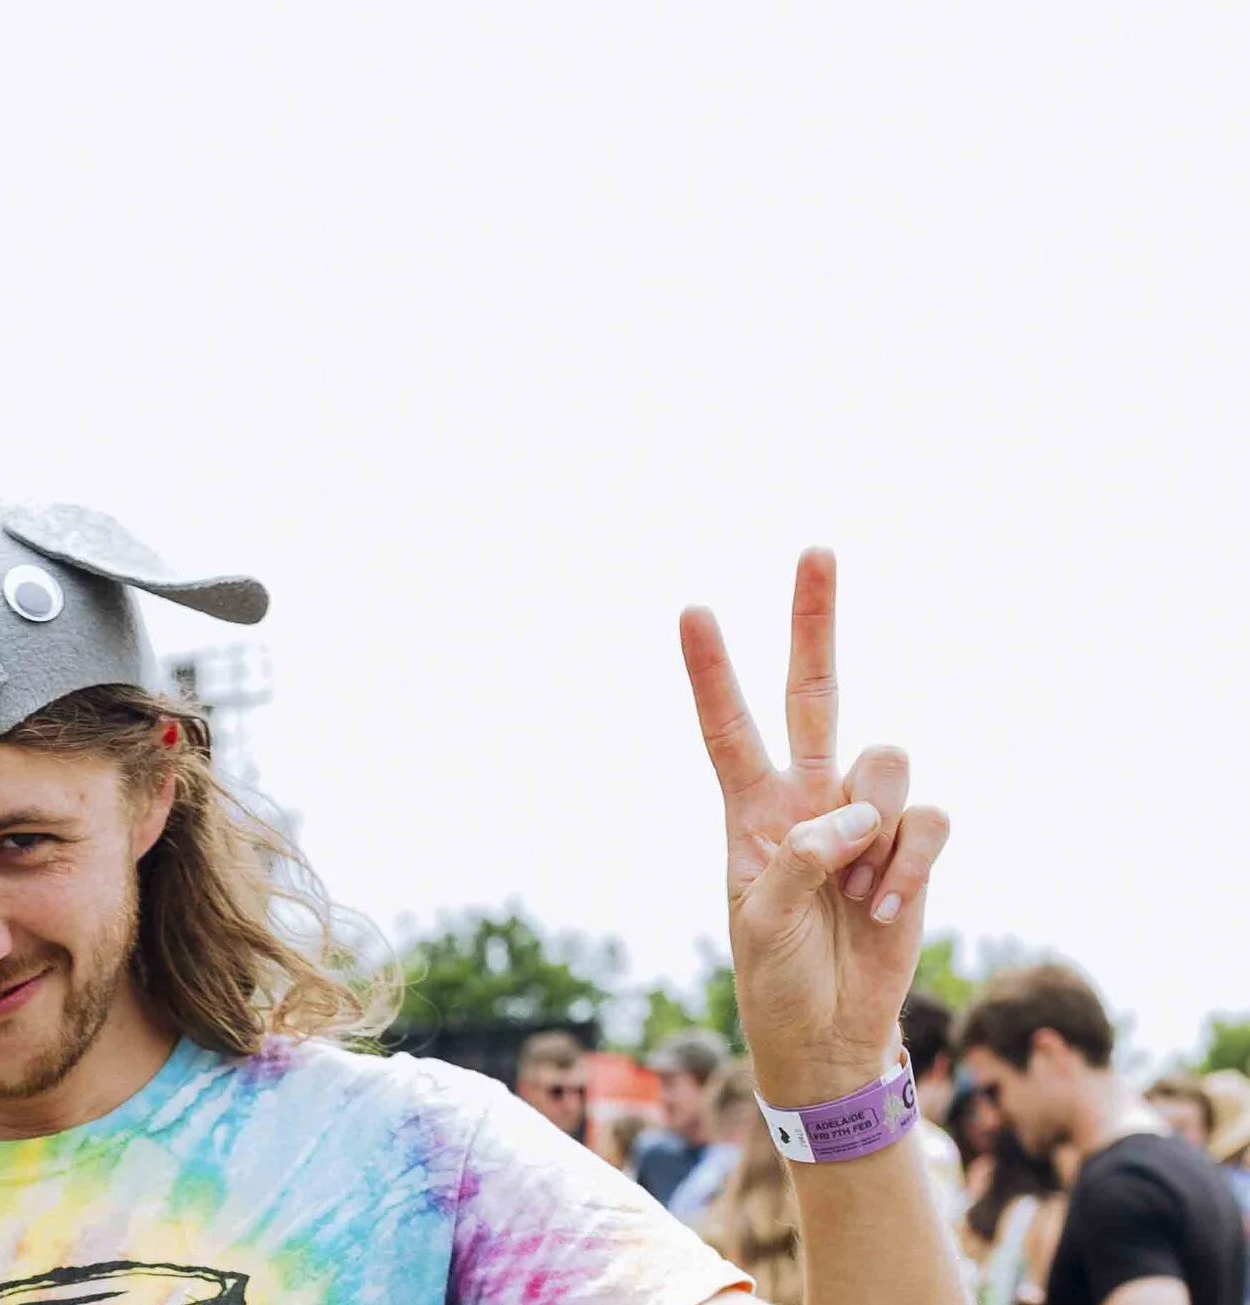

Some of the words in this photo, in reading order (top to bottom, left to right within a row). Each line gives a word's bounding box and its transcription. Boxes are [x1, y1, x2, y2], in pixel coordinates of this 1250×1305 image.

[813, 1132, 830, 1141] FRI
[831, 1126, 851, 1138] 7TH
[852, 1119, 872, 1133] FEB
[815, 1111, 865, 1131] ADELAIDE
